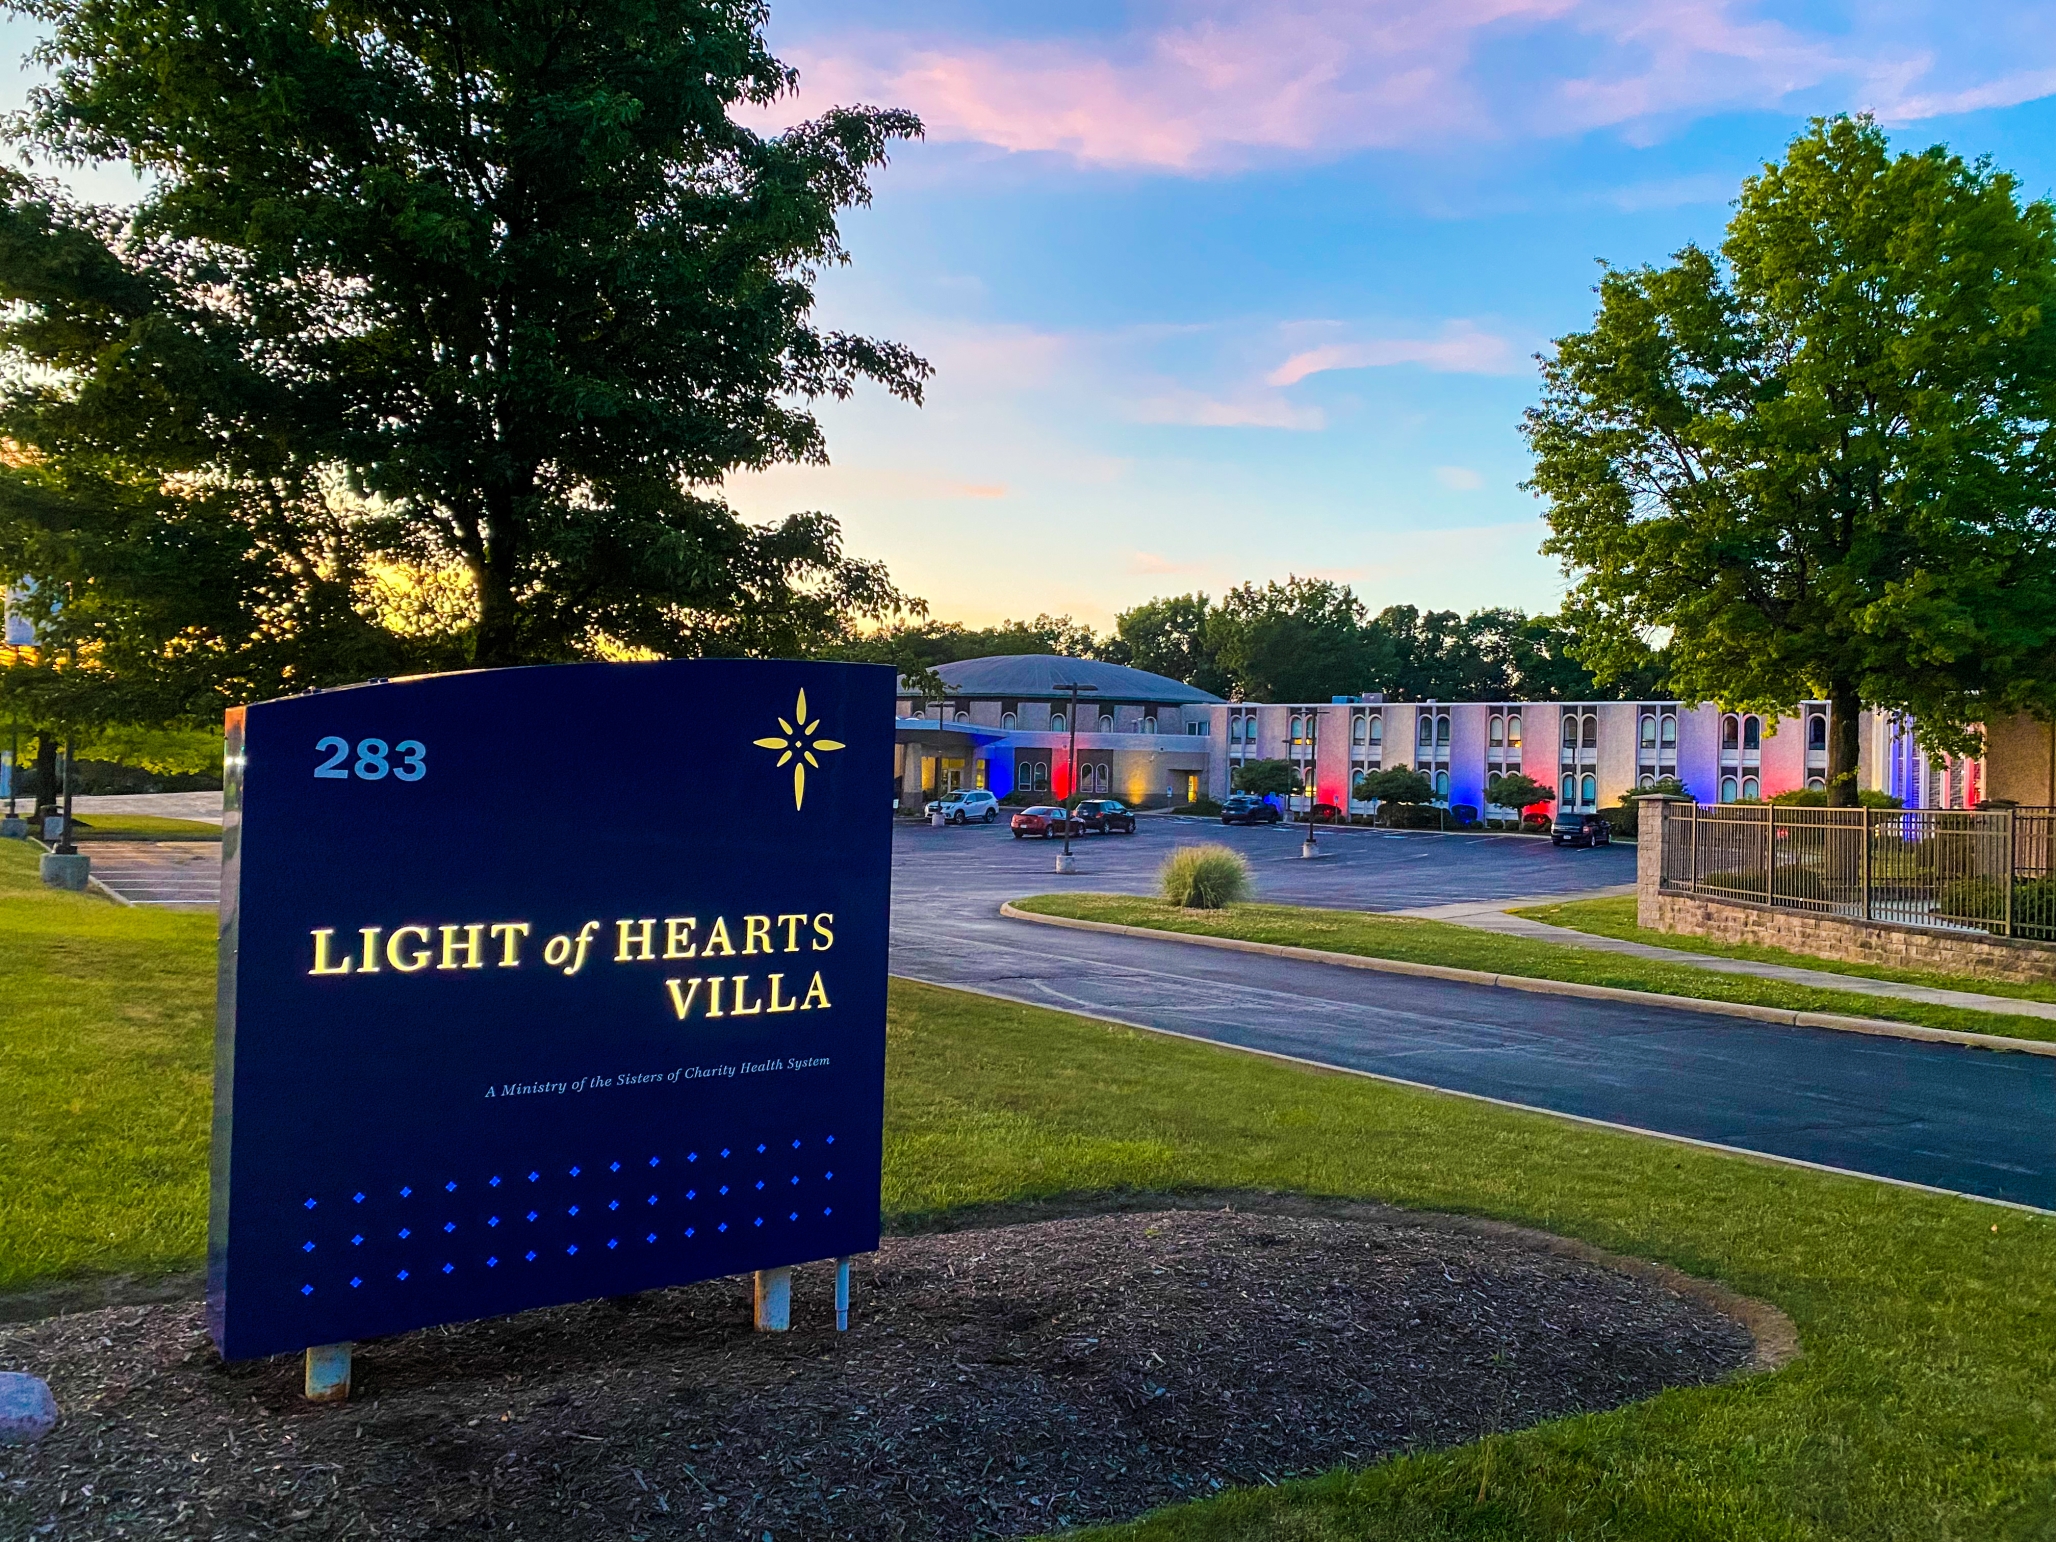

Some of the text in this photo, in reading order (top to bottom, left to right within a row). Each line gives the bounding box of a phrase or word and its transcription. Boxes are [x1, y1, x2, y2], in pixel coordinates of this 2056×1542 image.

[313, 735, 427, 782] 283
[307, 912, 835, 977] LIGHT of HEARTS
[664, 969, 832, 1021] VILLA
[484, 1057, 830, 1098] A Ministry of the Sisters of Charity Health System
